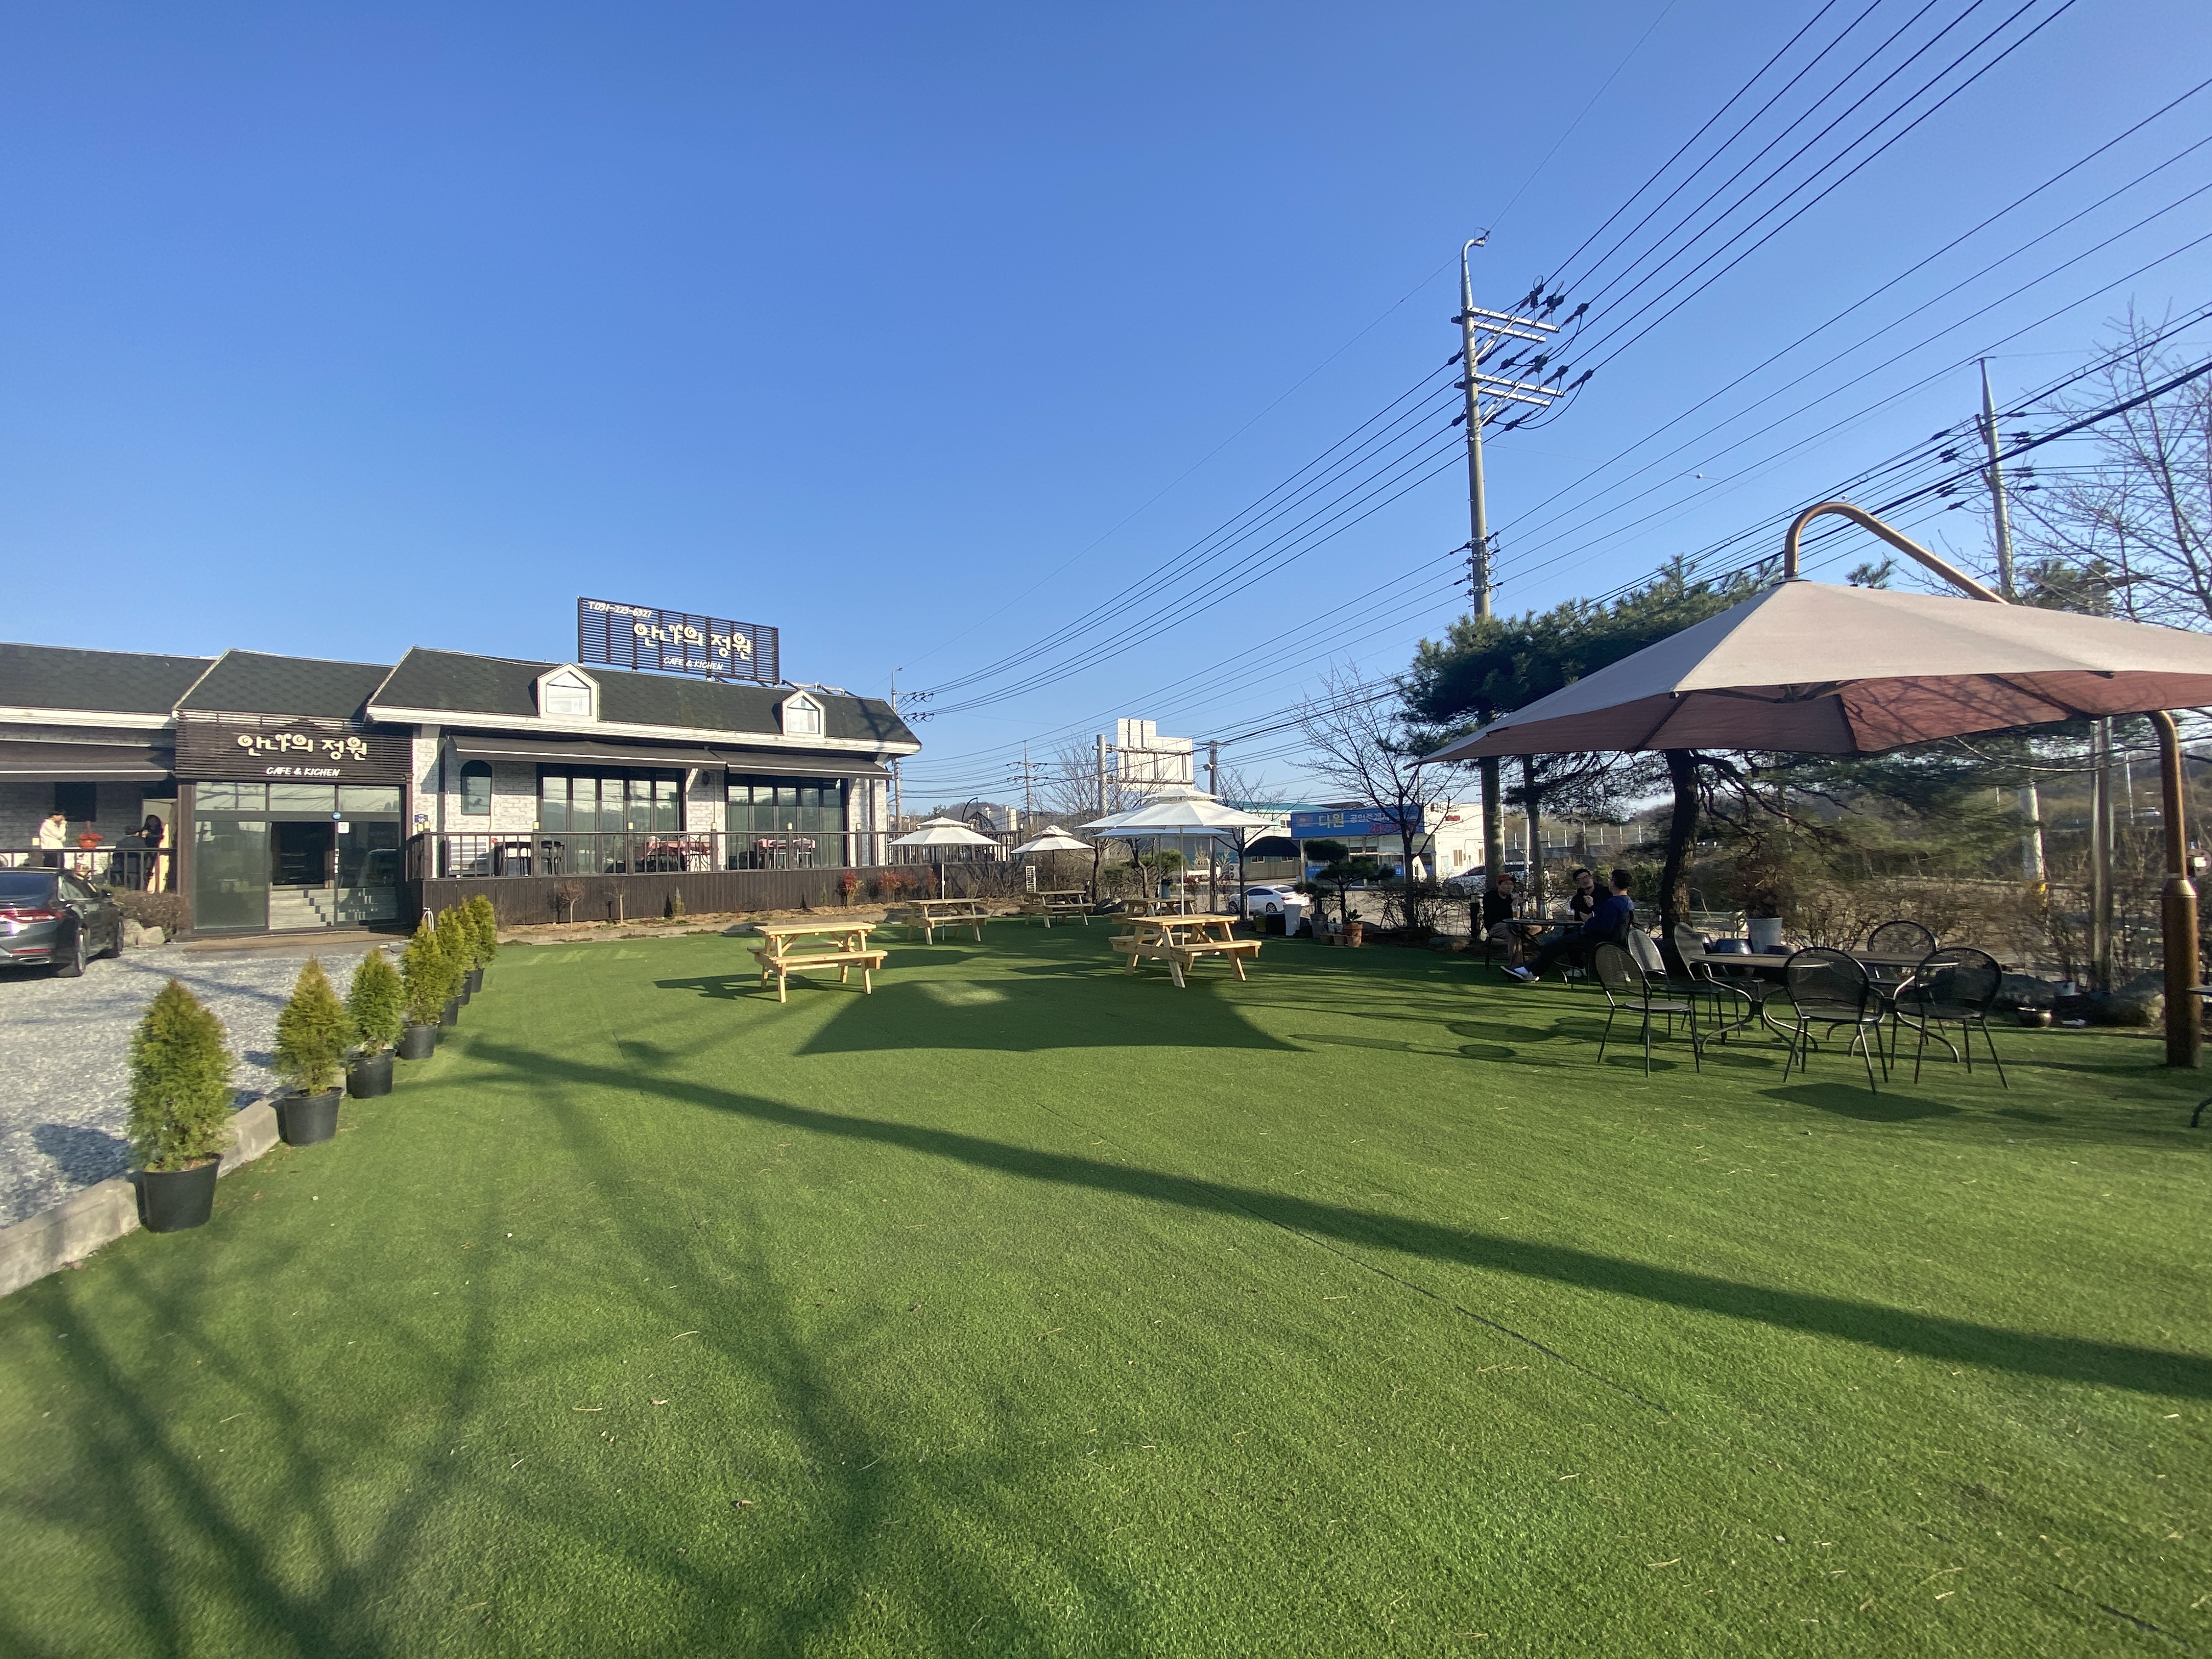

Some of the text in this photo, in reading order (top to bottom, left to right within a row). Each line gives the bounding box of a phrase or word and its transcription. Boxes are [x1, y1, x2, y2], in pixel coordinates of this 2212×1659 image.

[710, 633, 751, 660] 정원
[663, 656, 684, 666] CAFE
[693, 660, 724, 671] KICHEN
[321, 737, 367, 760] 정원
[266, 767, 292, 775] CAFE
[304, 768, 341, 777] KICHEN
[1318, 813, 1344, 828] 다원
